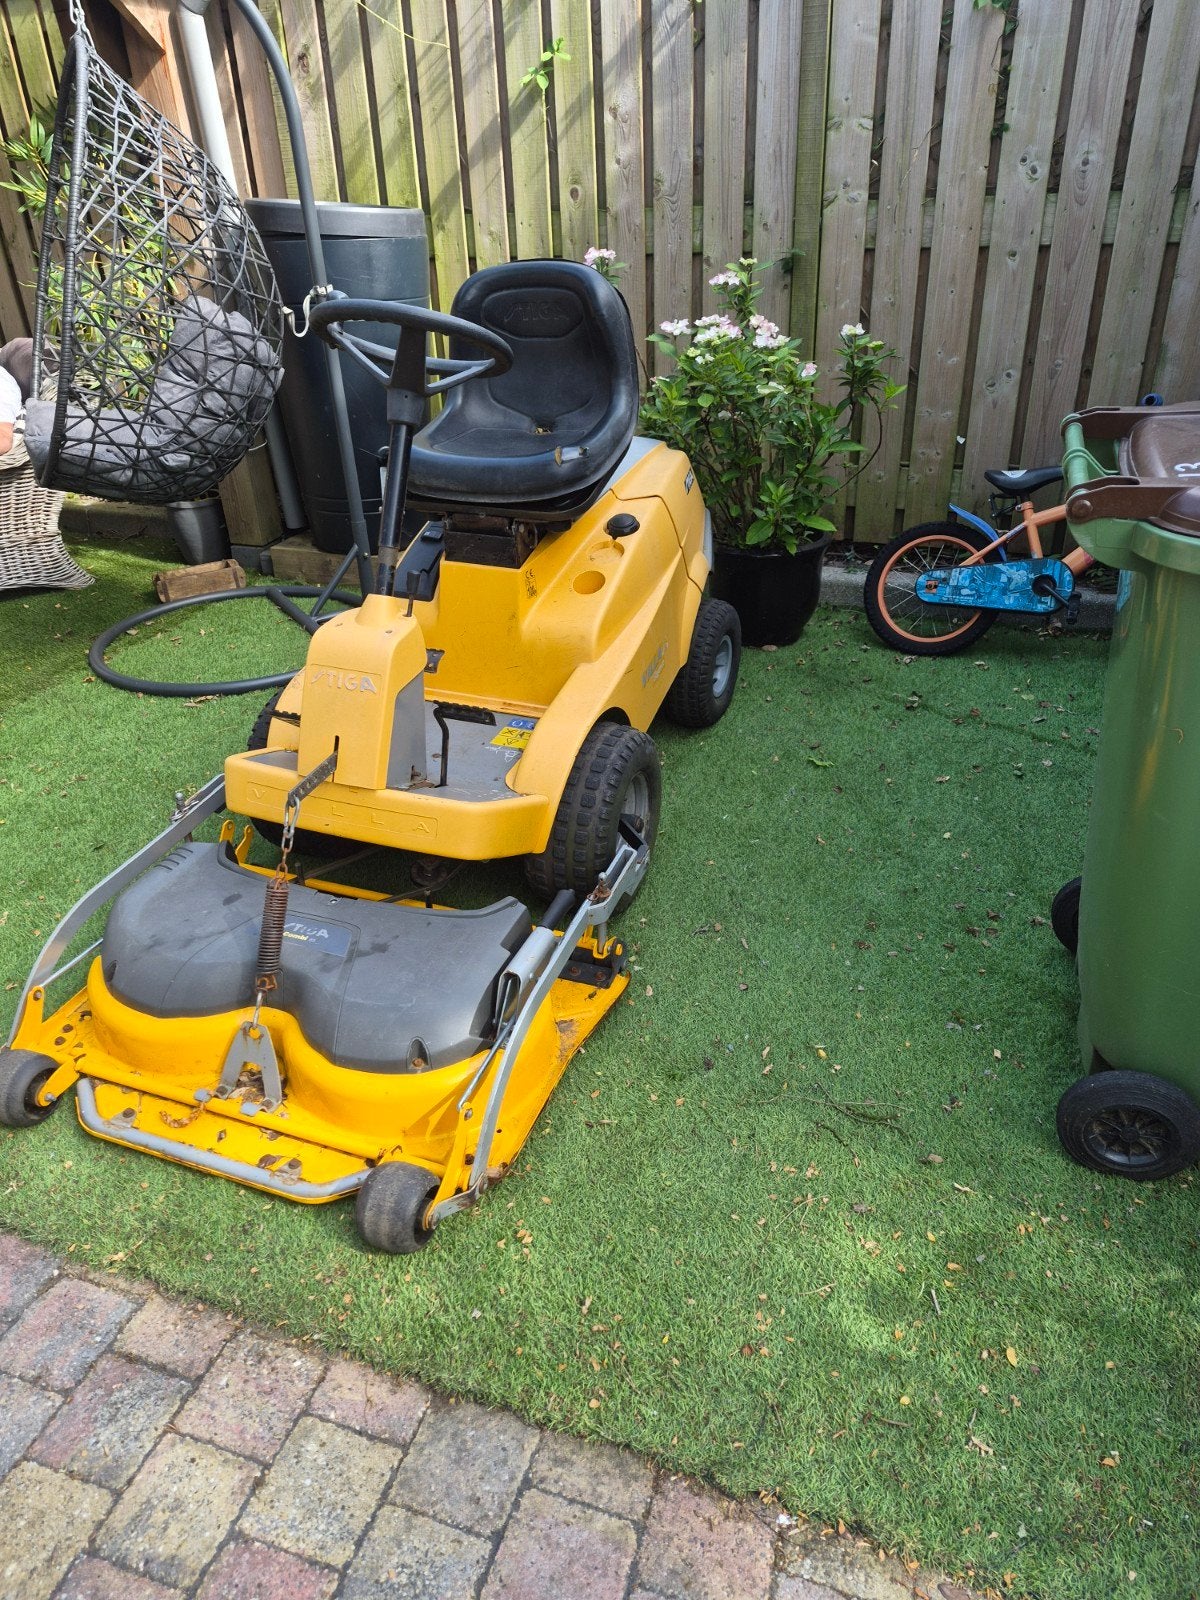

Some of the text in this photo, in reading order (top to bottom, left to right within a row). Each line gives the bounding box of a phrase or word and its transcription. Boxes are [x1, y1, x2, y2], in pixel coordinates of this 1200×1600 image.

[311, 669, 377, 694] STIGA
[251, 787, 431, 834] VLLA
[282, 931, 309, 941] Combi
